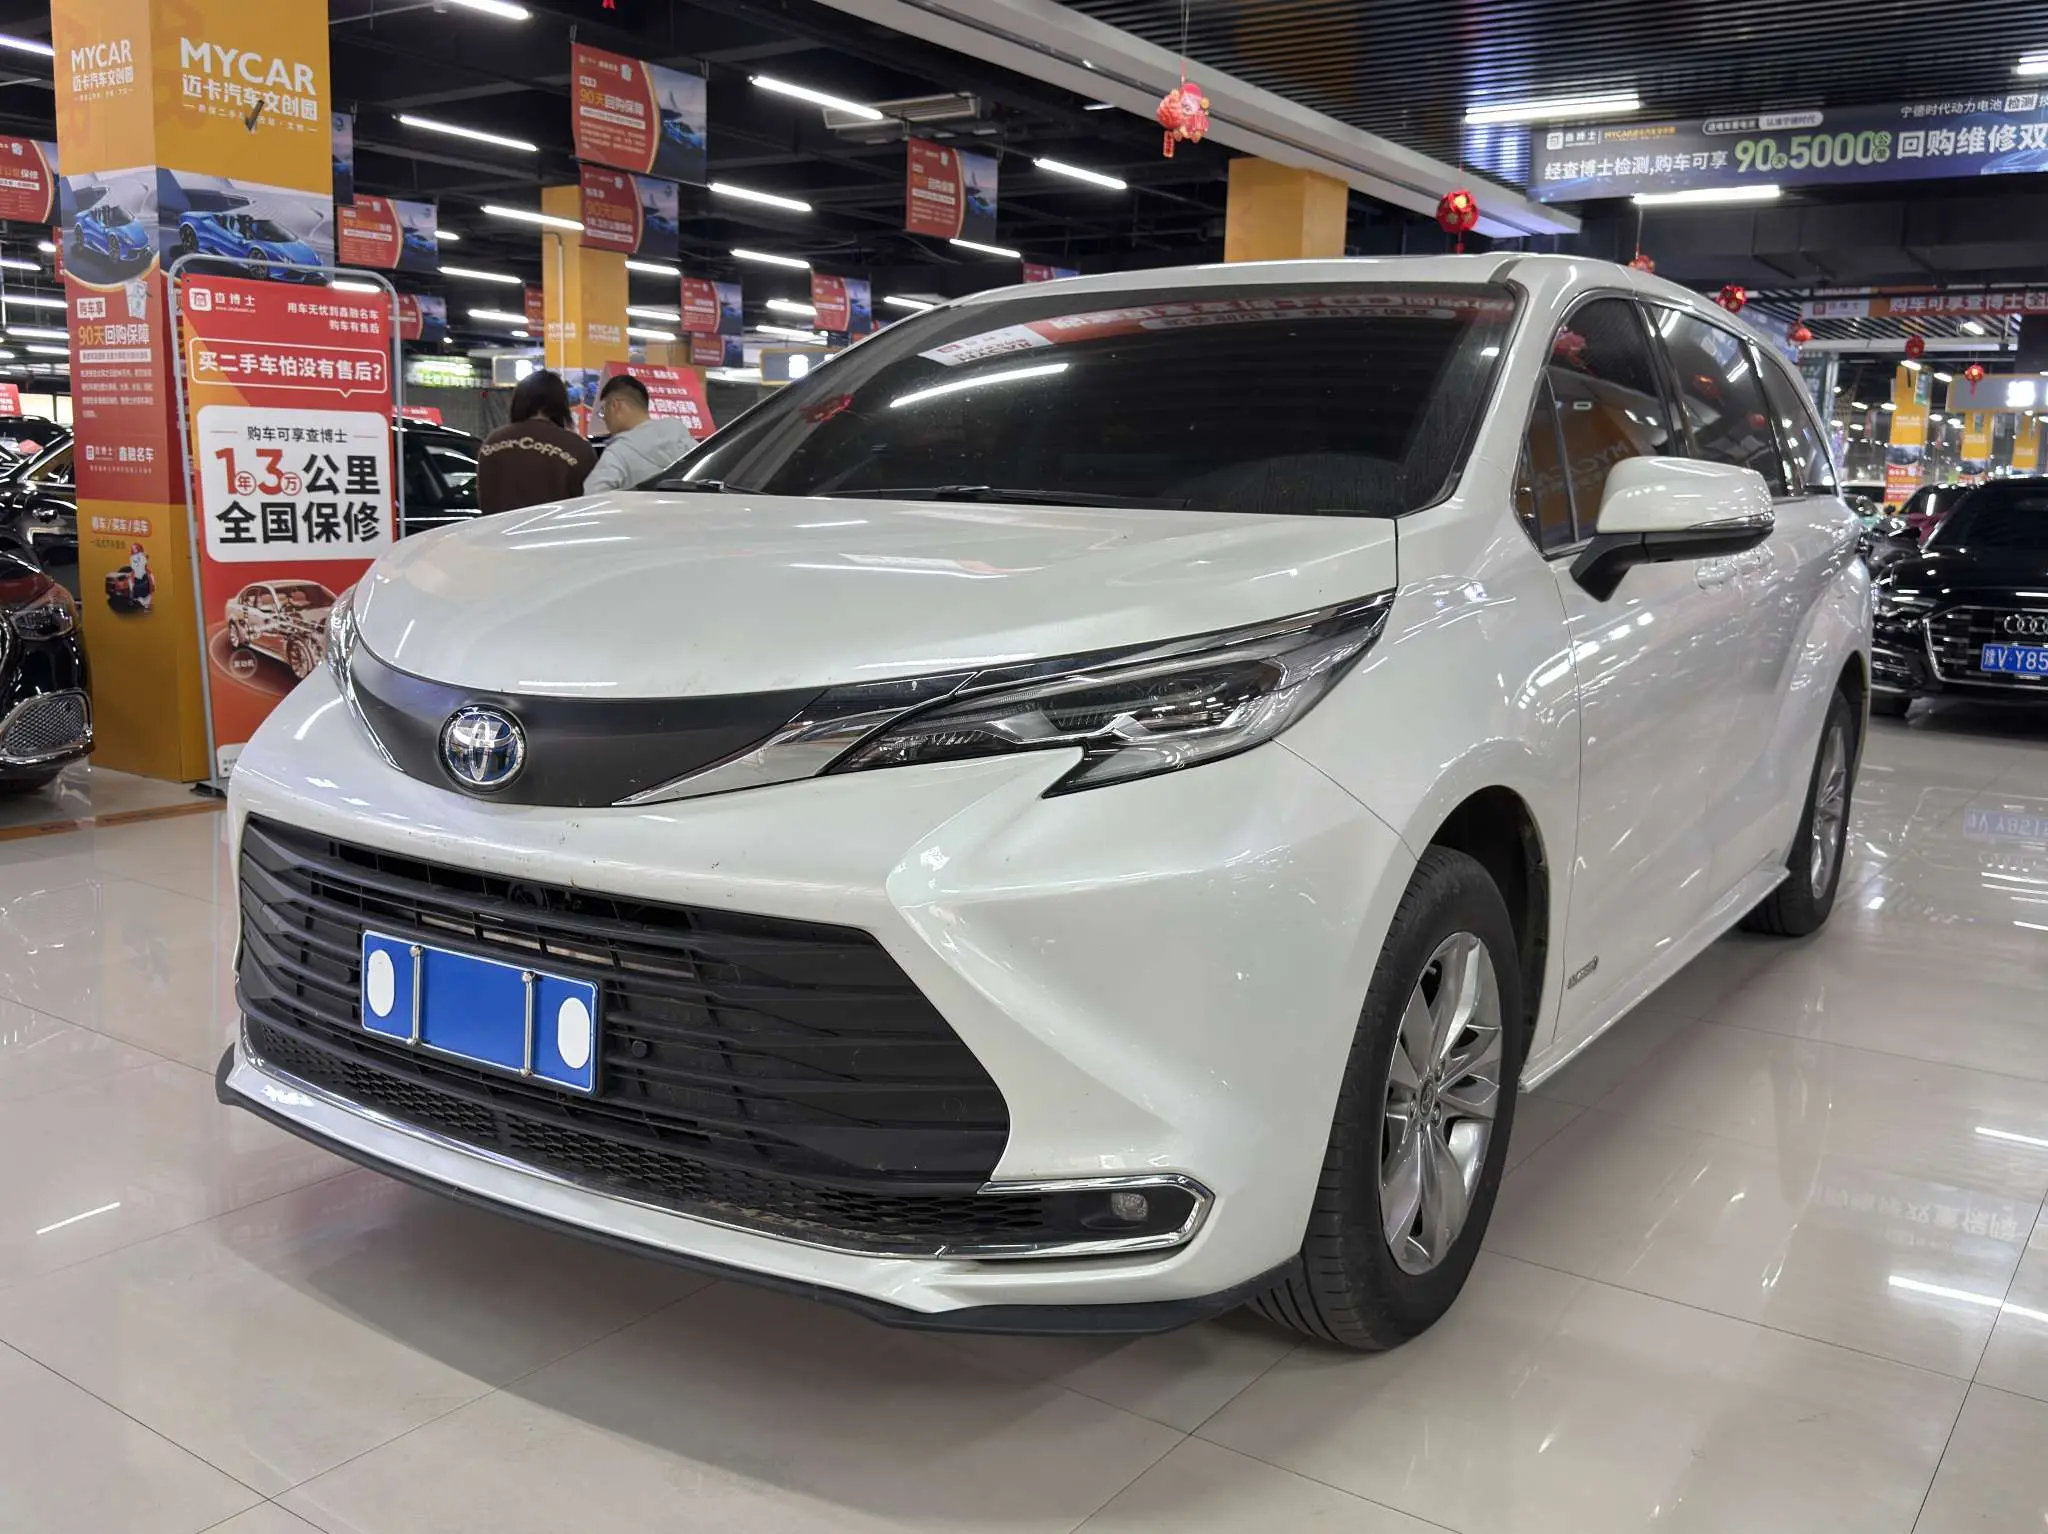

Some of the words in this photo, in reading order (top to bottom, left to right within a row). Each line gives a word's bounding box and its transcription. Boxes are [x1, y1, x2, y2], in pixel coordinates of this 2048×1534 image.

[72, 39, 132, 73] MYCAR
[181, 37, 316, 96] MYCAR
[183, 73, 317, 121] 迈卡汽车文创园
[79, 323, 150, 346] 90天回购保障
[330, 320, 380, 334] 购车有售后
[199, 351, 382, 381] 买二手车怕没有售后?
[247, 426, 348, 443] 购车可享查博士
[216, 500, 380, 544] 全国保修
